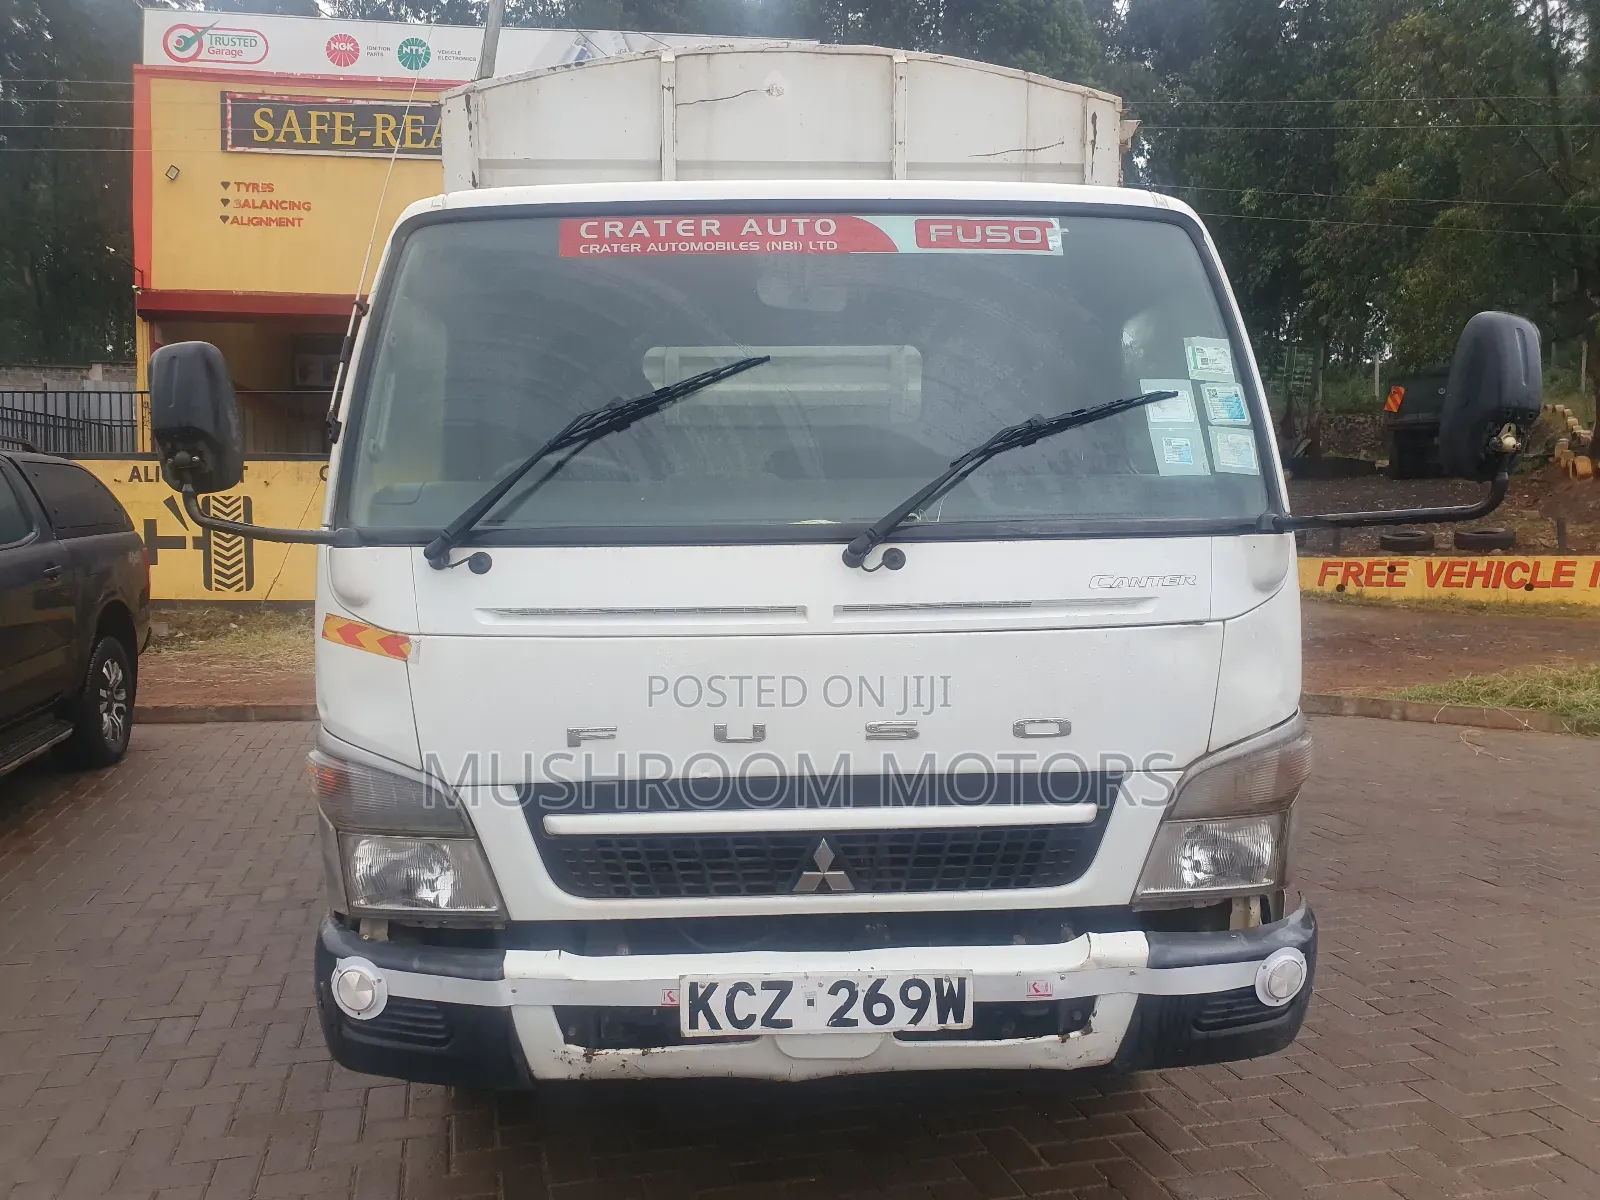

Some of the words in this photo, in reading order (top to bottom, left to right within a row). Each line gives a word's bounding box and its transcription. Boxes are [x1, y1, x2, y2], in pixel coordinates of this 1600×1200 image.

[207, 33, 258, 48] TRUSTED
[330, 42, 355, 52] NGK
[207, 46, 244, 58] Garage
[402, 46, 427, 55] NTK
[233, 181, 275, 193] TYRES
[229, 215, 304, 228] ALIGNMENT
[579, 218, 720, 239] CRATER
[740, 217, 838, 237] AUTO
[929, 224, 1042, 245] FUSO
[579, 243, 643, 254] CRATER
[646, 241, 760, 253] AUTOMOBILES
[765, 240, 803, 254] (NBI)
[808, 239, 839, 251] LTD
[1088, 573, 1197, 589] CANTER
[1318, 561, 1410, 588] FREE
[1425, 560, 1578, 589] VEHICLE
[566, 717, 1073, 748] FUSO
[689, 981, 793, 1030] KCZ
[827, 977, 966, 1027] 269W
